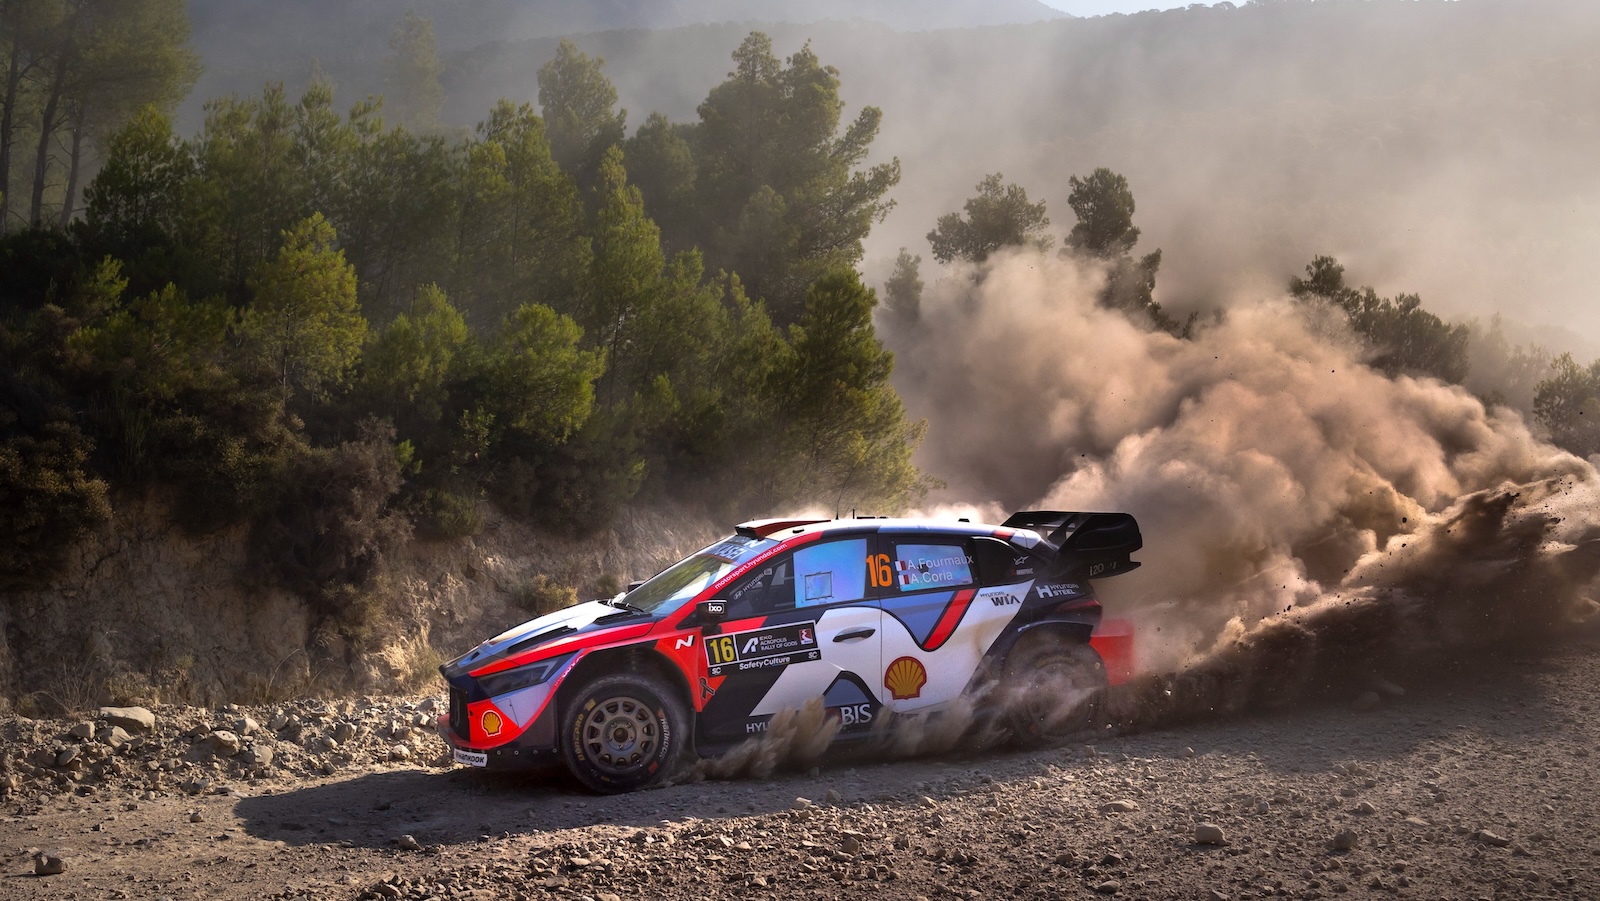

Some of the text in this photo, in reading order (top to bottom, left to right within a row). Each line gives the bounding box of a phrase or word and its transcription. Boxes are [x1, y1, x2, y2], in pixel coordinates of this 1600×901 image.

[714, 543, 788, 589] motorsport.hyundai.com
[907, 555, 974, 570] A.Fourmaux
[866, 553, 893, 588] 16
[910, 571, 953, 584] A.Coria
[760, 637, 788, 646] ACROPOLIS
[761, 643, 776, 651] RALLY
[709, 637, 735, 664] 16
[808, 651, 818, 659] SC
[739, 655, 791, 670] SafetyCulture
[711, 667, 722, 675] SC
